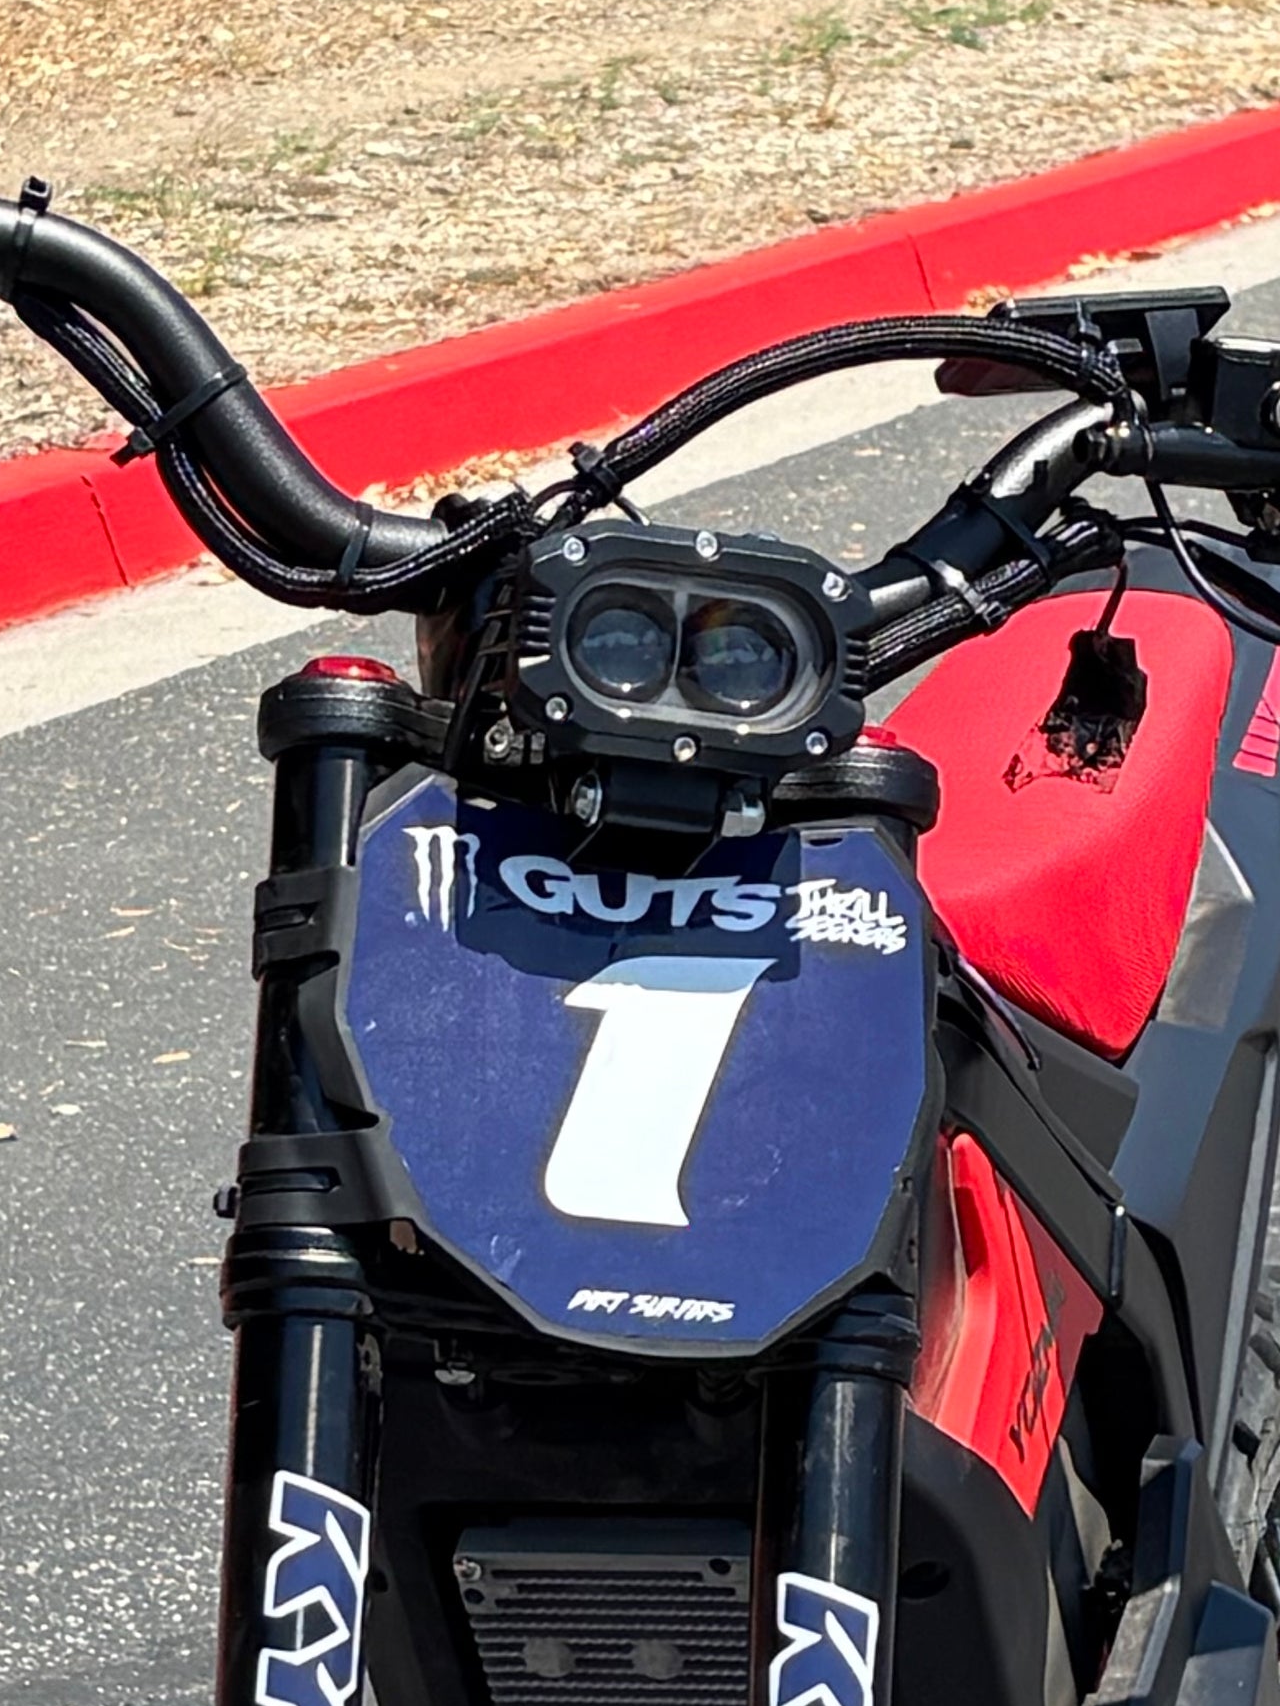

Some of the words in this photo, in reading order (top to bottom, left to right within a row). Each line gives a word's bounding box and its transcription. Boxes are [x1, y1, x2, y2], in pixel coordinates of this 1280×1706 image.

[498, 855, 782, 931] GUTS
[785, 879, 904, 927] THRILL
[544, 955, 778, 1227] 1
